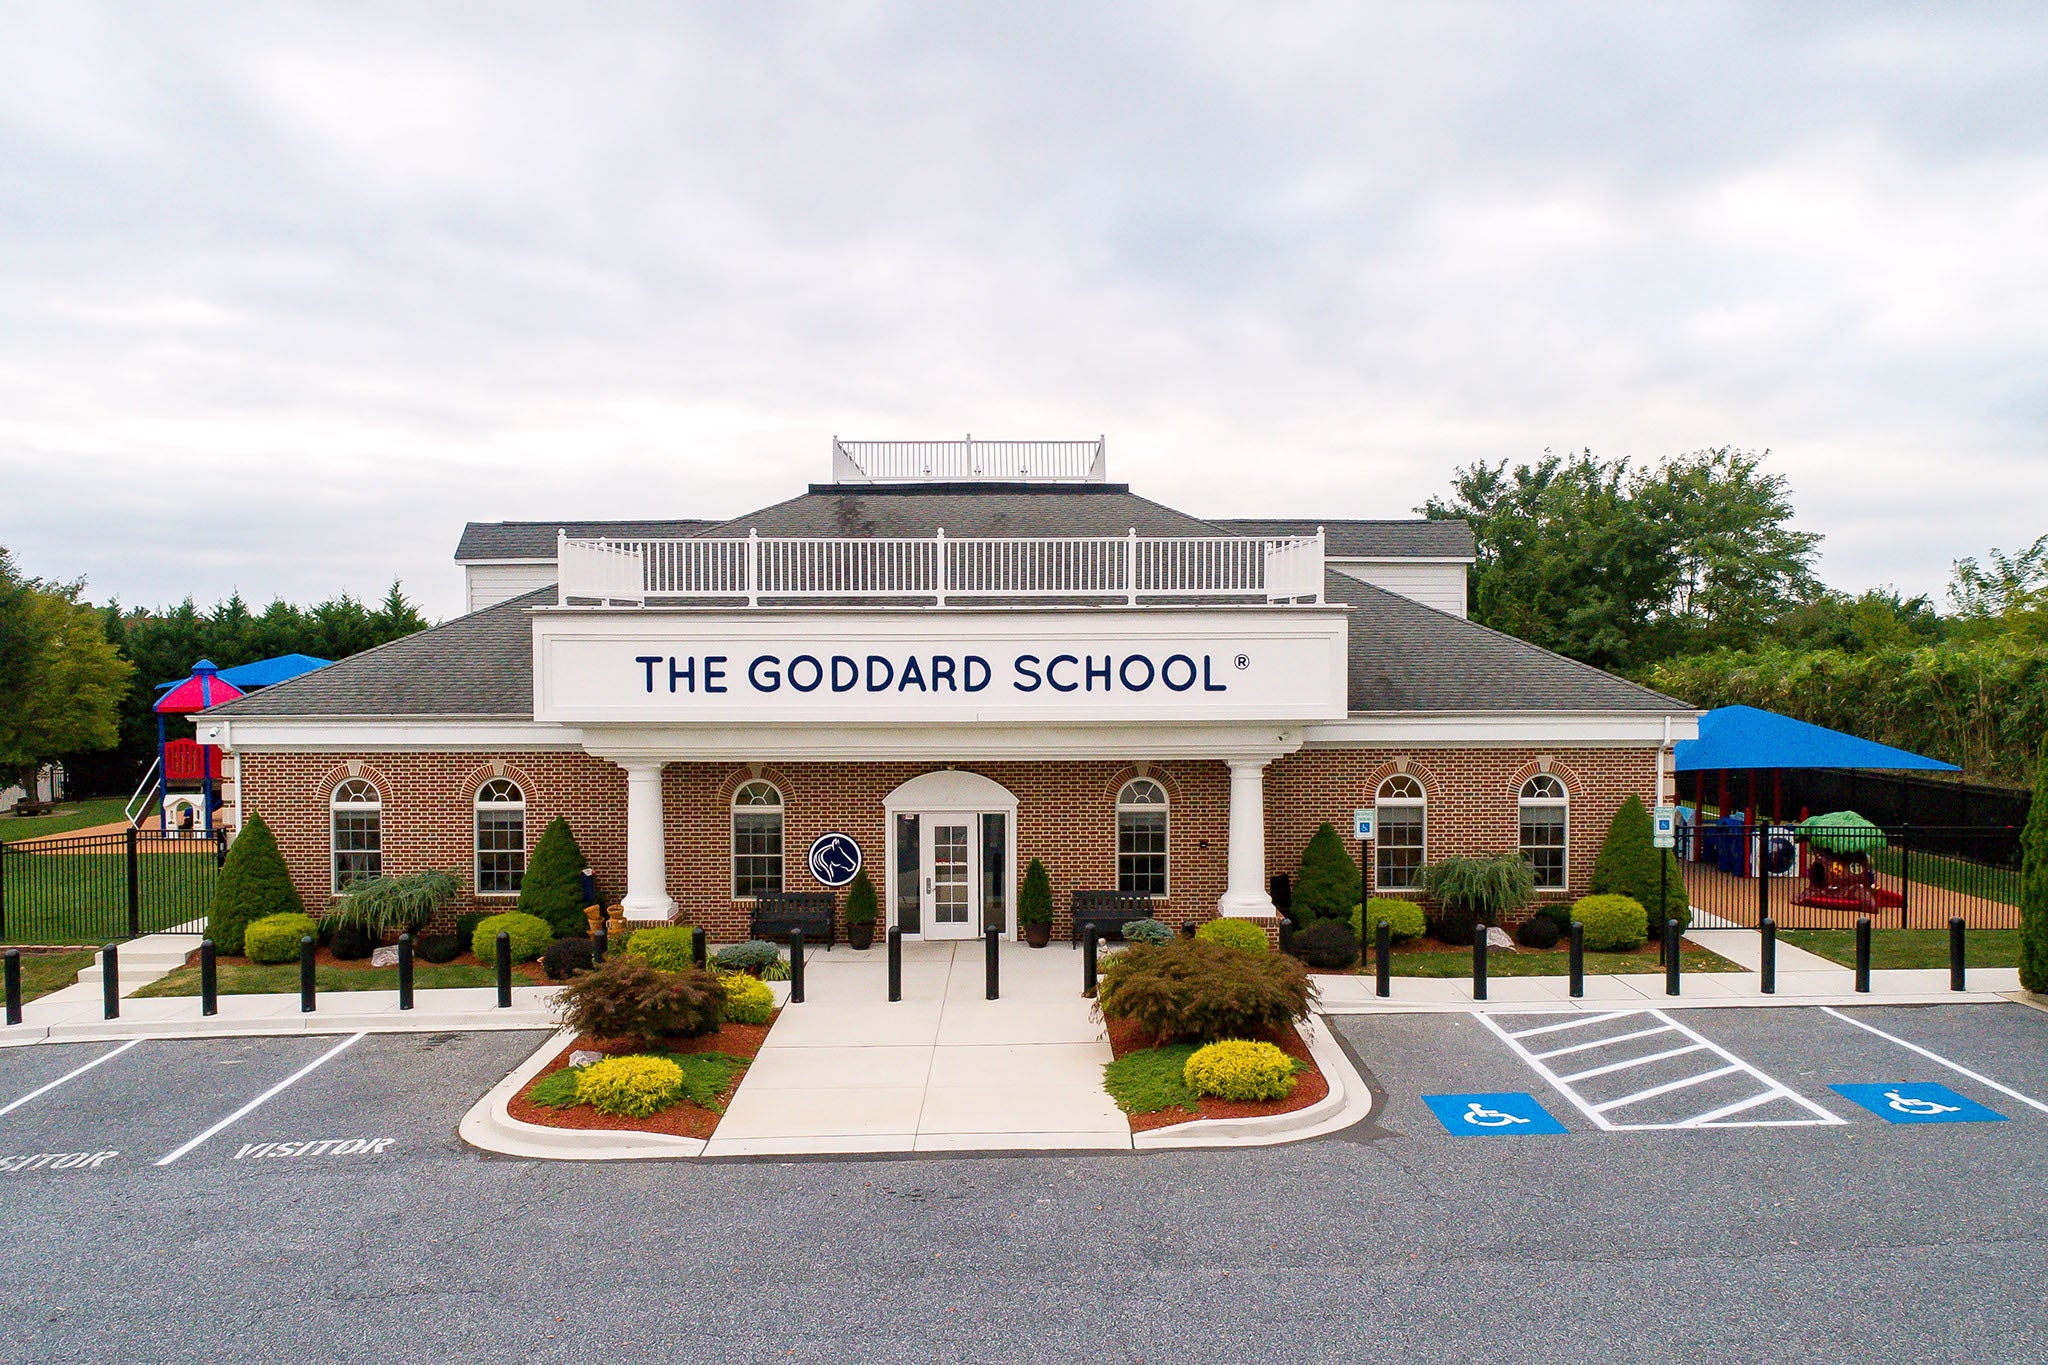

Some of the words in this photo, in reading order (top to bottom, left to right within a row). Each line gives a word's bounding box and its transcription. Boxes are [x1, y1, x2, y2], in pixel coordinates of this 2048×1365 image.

[635, 656, 728, 693] THE
[747, 654, 991, 693] GODDARD
[1013, 653, 1227, 693] SCHOOL
[233, 1137, 396, 1160] VISITOR
[0, 1150, 120, 1172] SITOR
